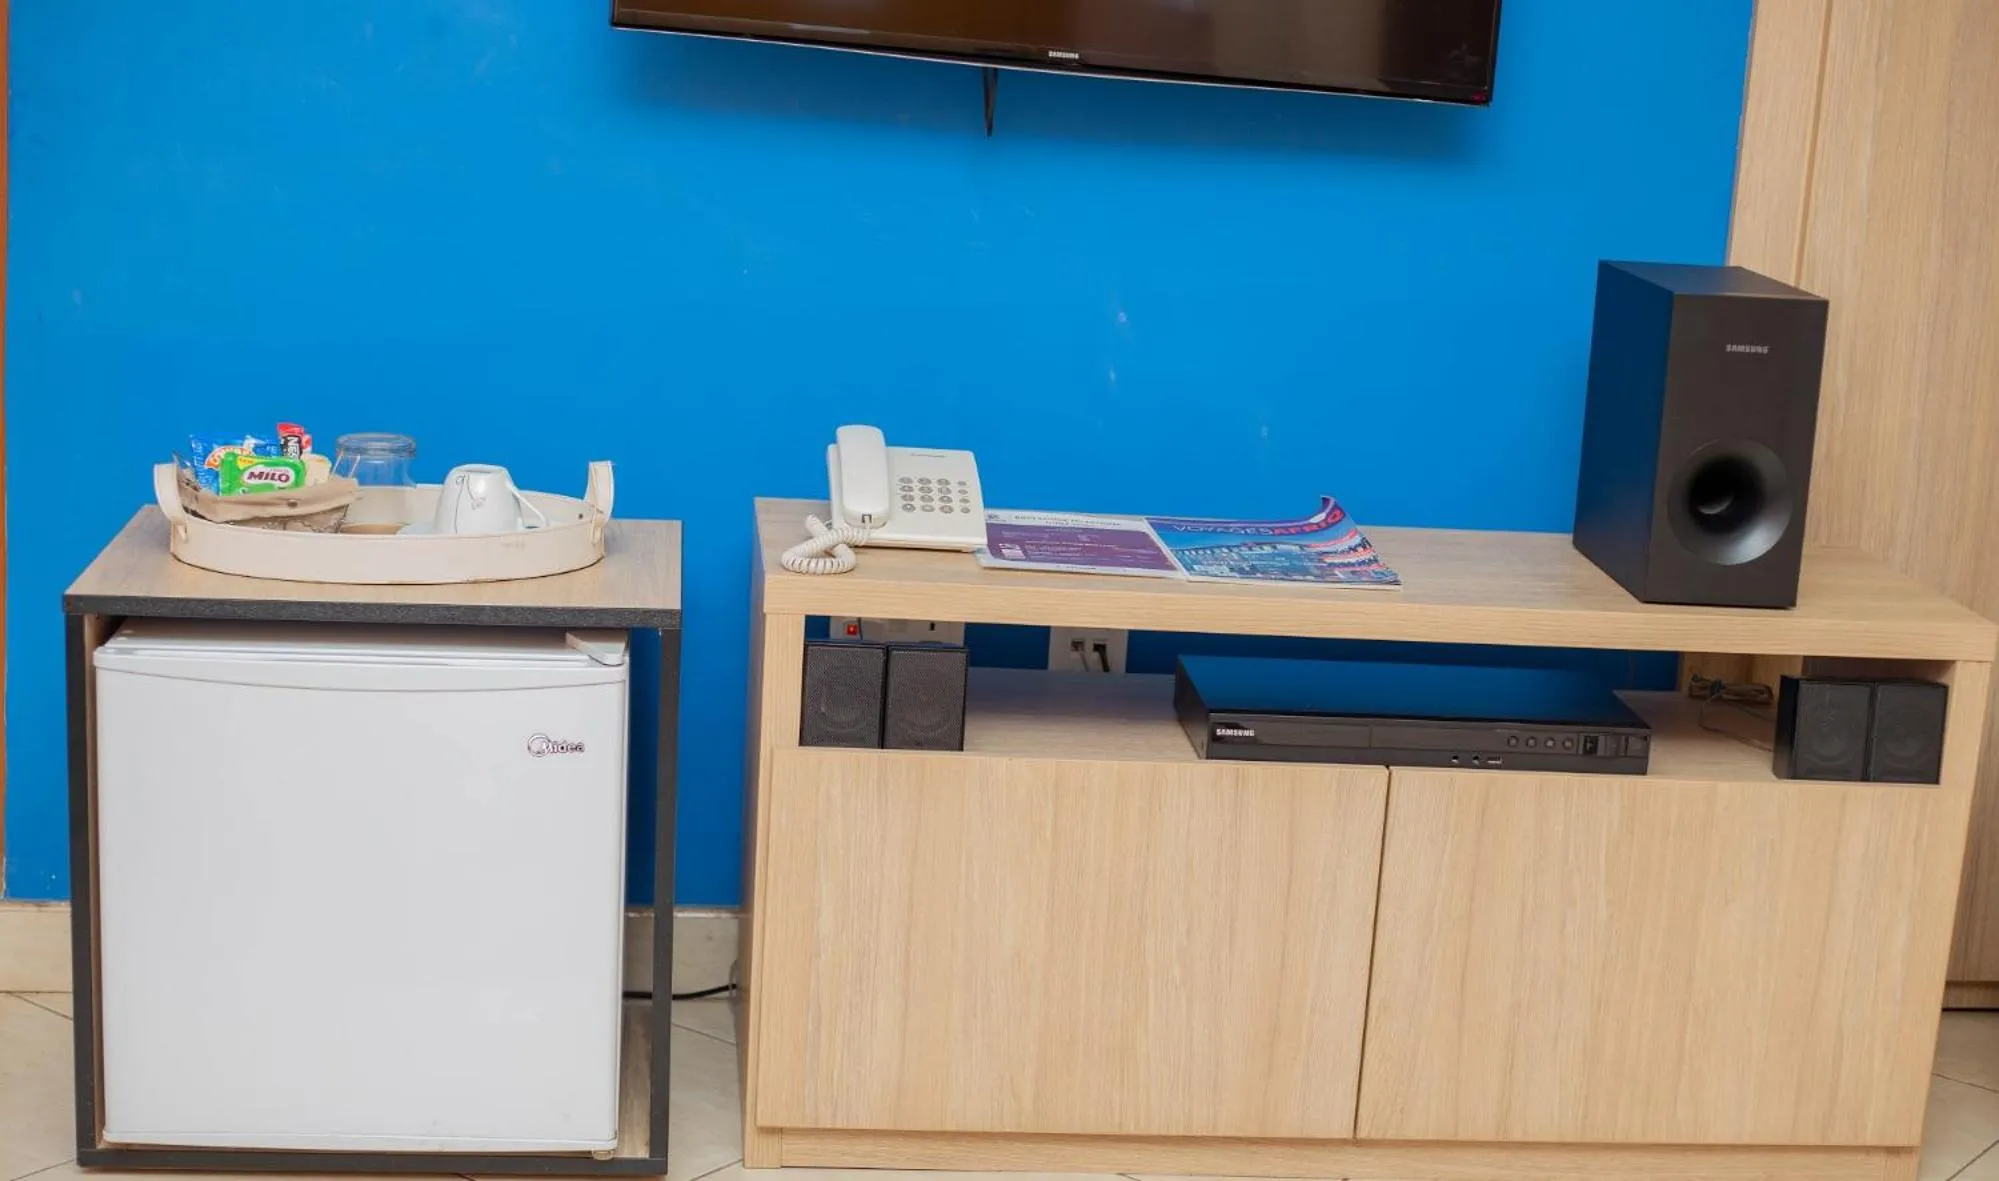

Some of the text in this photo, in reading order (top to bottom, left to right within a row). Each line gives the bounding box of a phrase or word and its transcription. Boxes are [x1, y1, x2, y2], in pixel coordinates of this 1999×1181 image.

[1048, 50, 1080, 60] SAMSUNG
[1725, 343, 1769, 354] SAMSUNG
[246, 470, 291, 484] MILO
[1215, 728, 1256, 737] SAMSUNG
[538, 738, 585, 755] Midea
